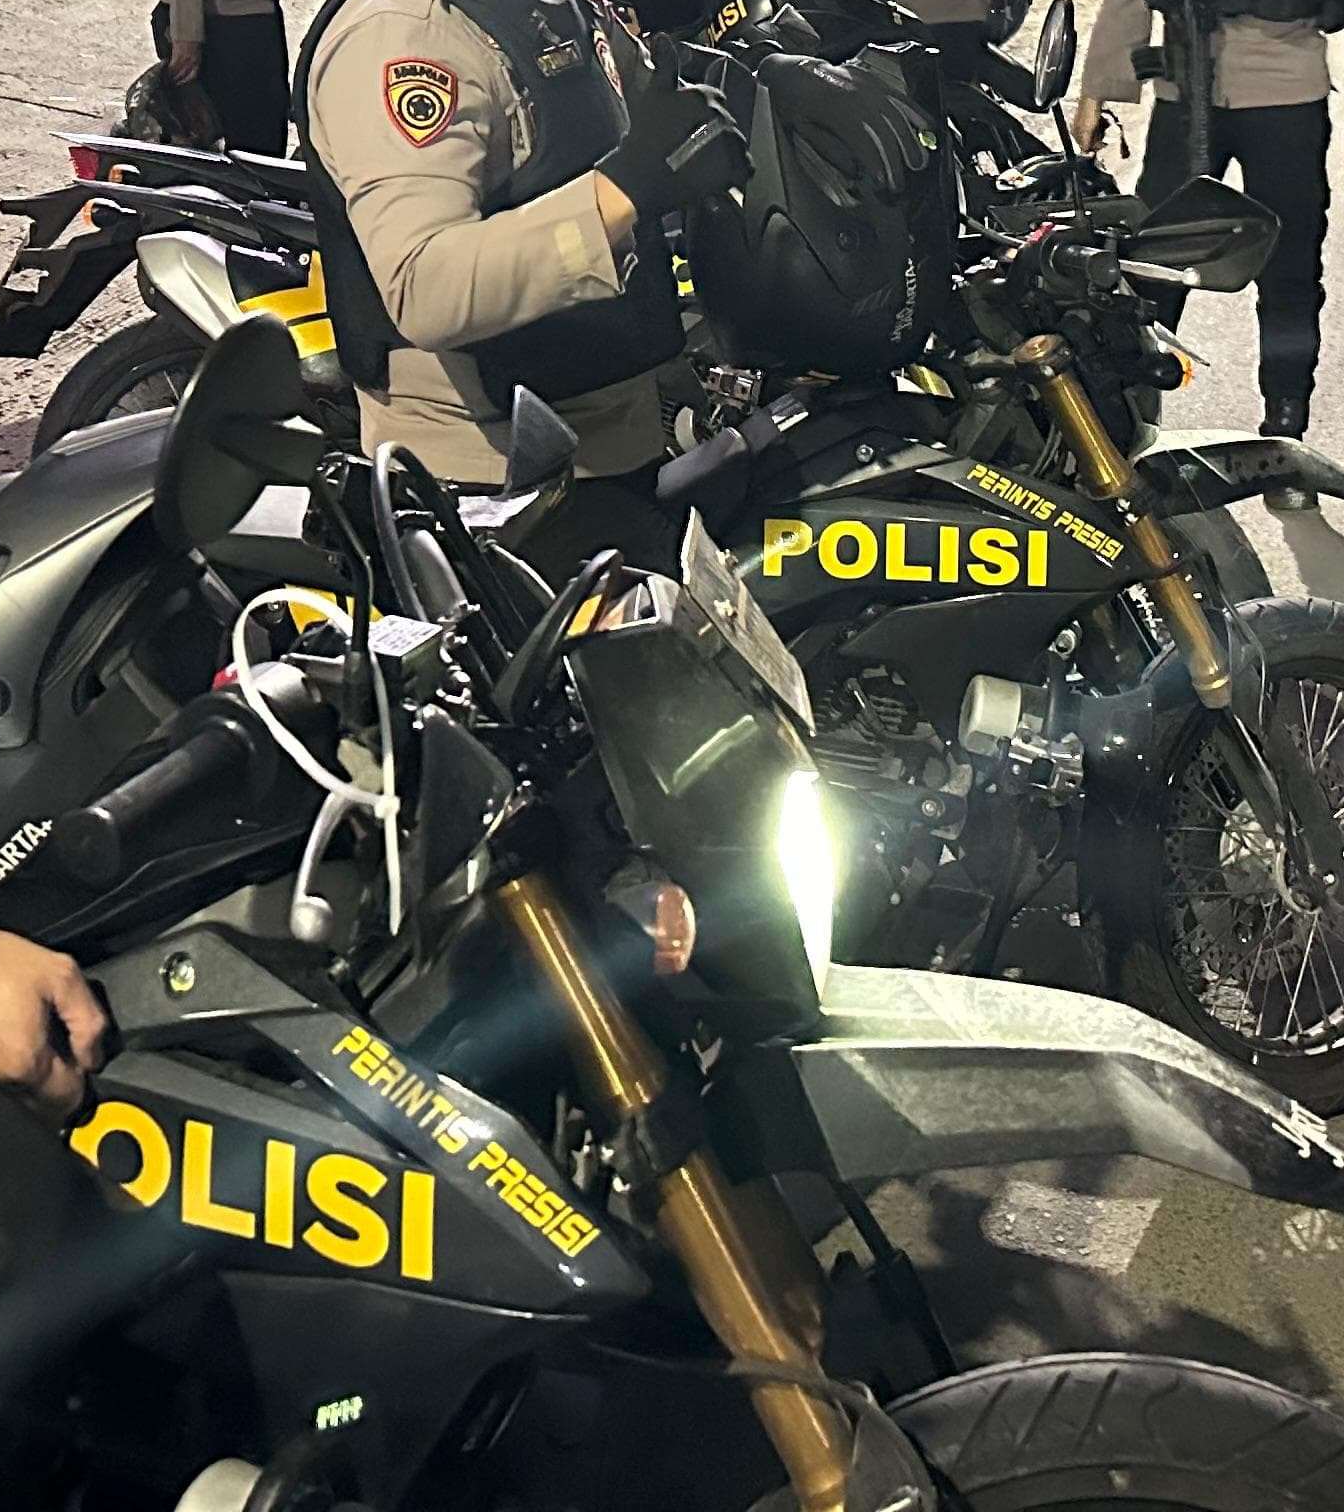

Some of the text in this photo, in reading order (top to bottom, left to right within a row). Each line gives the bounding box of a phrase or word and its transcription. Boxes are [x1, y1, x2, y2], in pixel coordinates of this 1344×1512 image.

[763, 518, 1049, 587] POLISI
[965, 464, 1125, 562] PERINTIS PRESISI
[69, 1100, 436, 1281] OLISI
[332, 1025, 602, 1258] PERINTIS PRESISI
